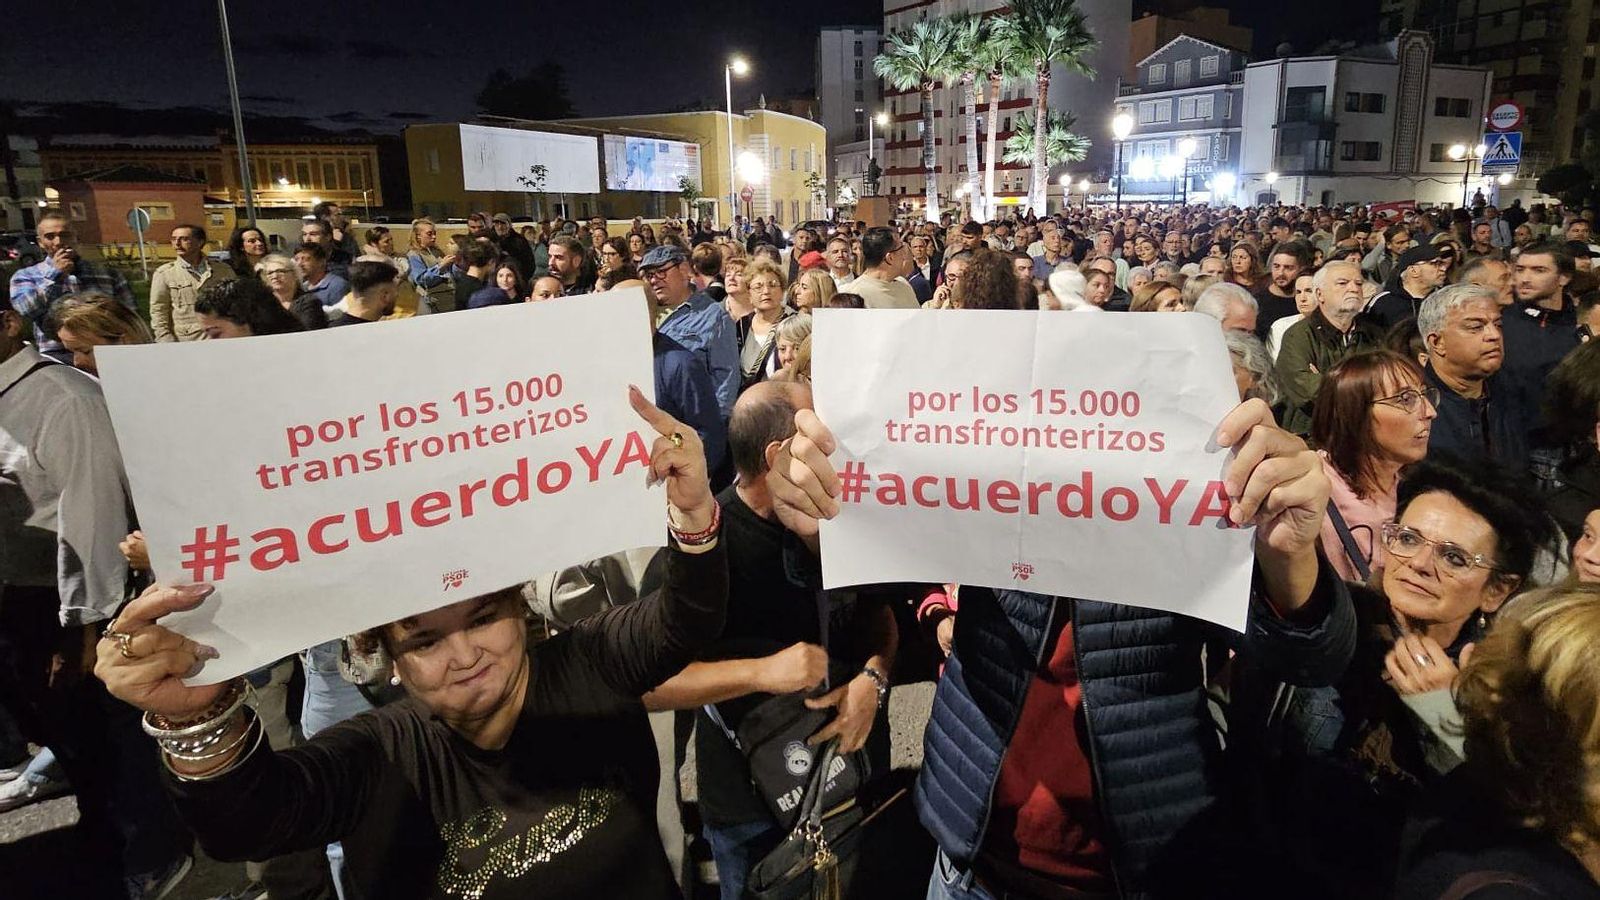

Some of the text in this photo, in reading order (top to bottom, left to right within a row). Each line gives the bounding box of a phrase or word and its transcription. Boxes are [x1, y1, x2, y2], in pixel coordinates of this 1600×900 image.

[286, 373, 564, 458] por los 15.000
[907, 386, 1140, 418] por los 15.000
[256, 402, 590, 490] transfronterizos
[886, 418, 1166, 453] transfronterizos
[180, 431, 650, 585] #acuerdoYA
[837, 461, 1240, 529] #acuerdoYA
[443, 571, 469, 583] PSOE
[1012, 565, 1035, 574] PSOE
